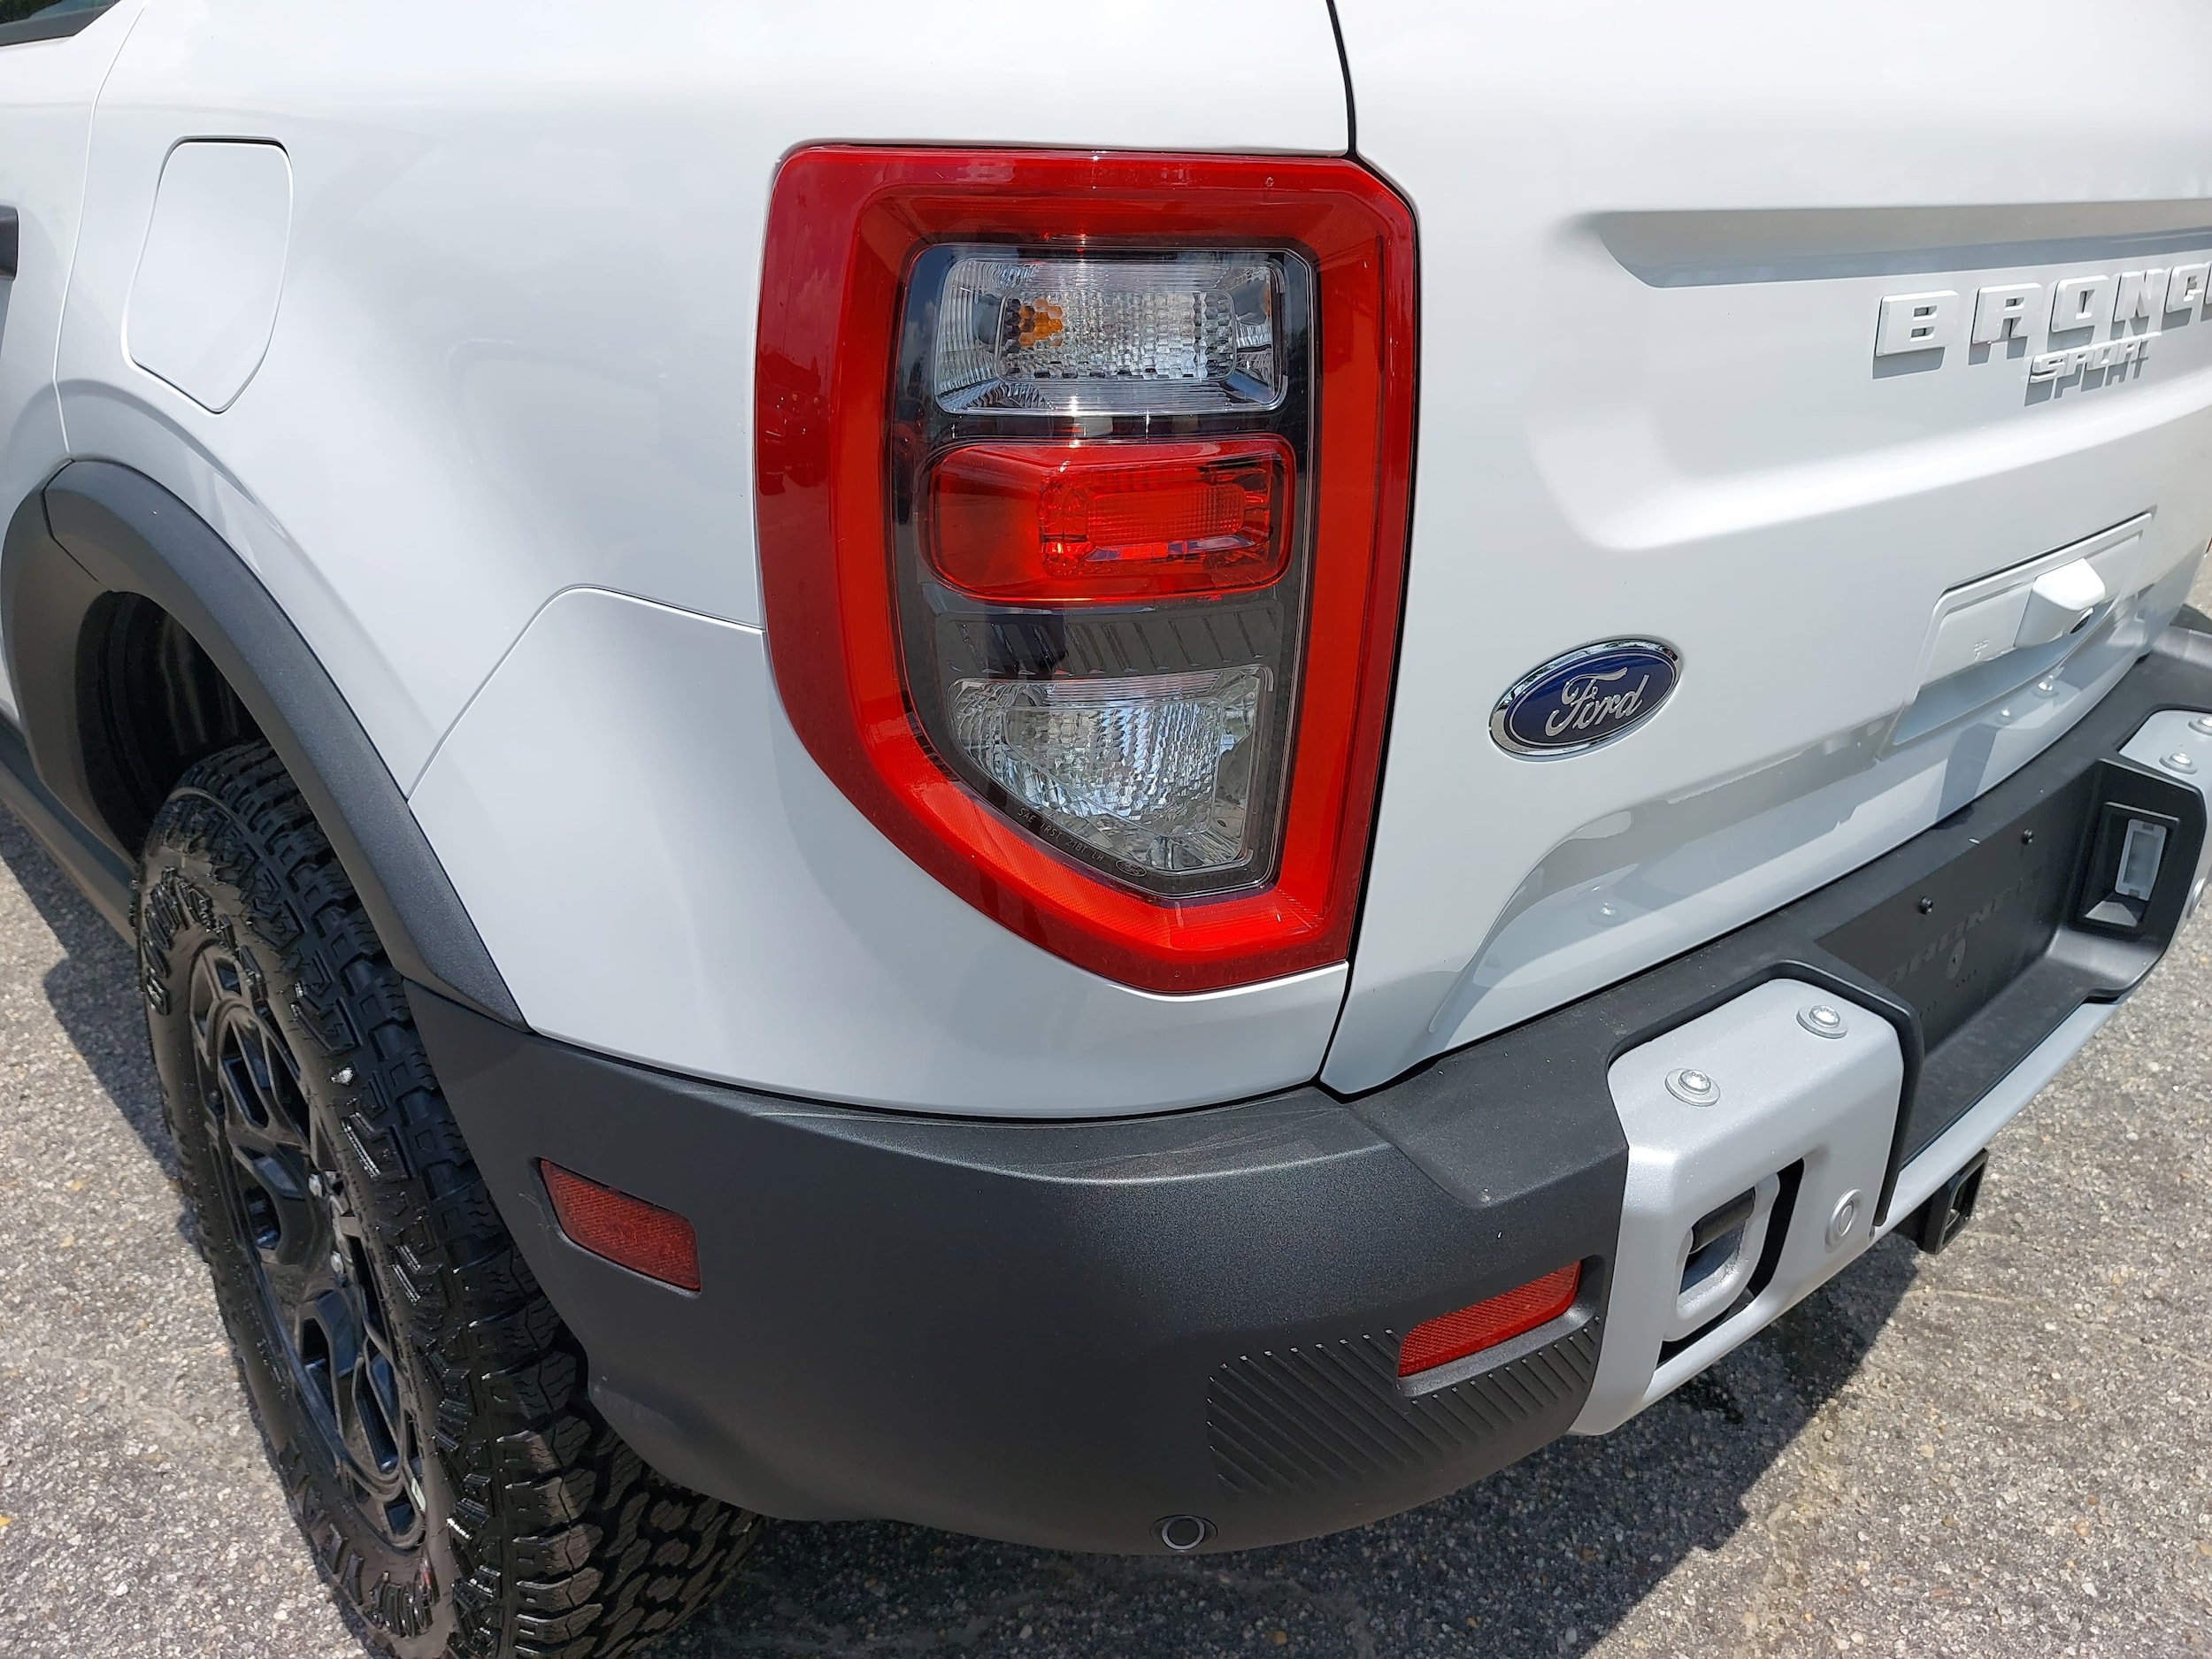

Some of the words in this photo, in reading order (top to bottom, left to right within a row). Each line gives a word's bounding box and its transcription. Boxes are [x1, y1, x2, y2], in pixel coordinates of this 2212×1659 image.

[1875, 261, 2212, 357] BRONC
[2030, 332, 2162, 384] SPORT
[1545, 667, 1649, 736] Ford
[1018, 807, 1037, 824] SAE
